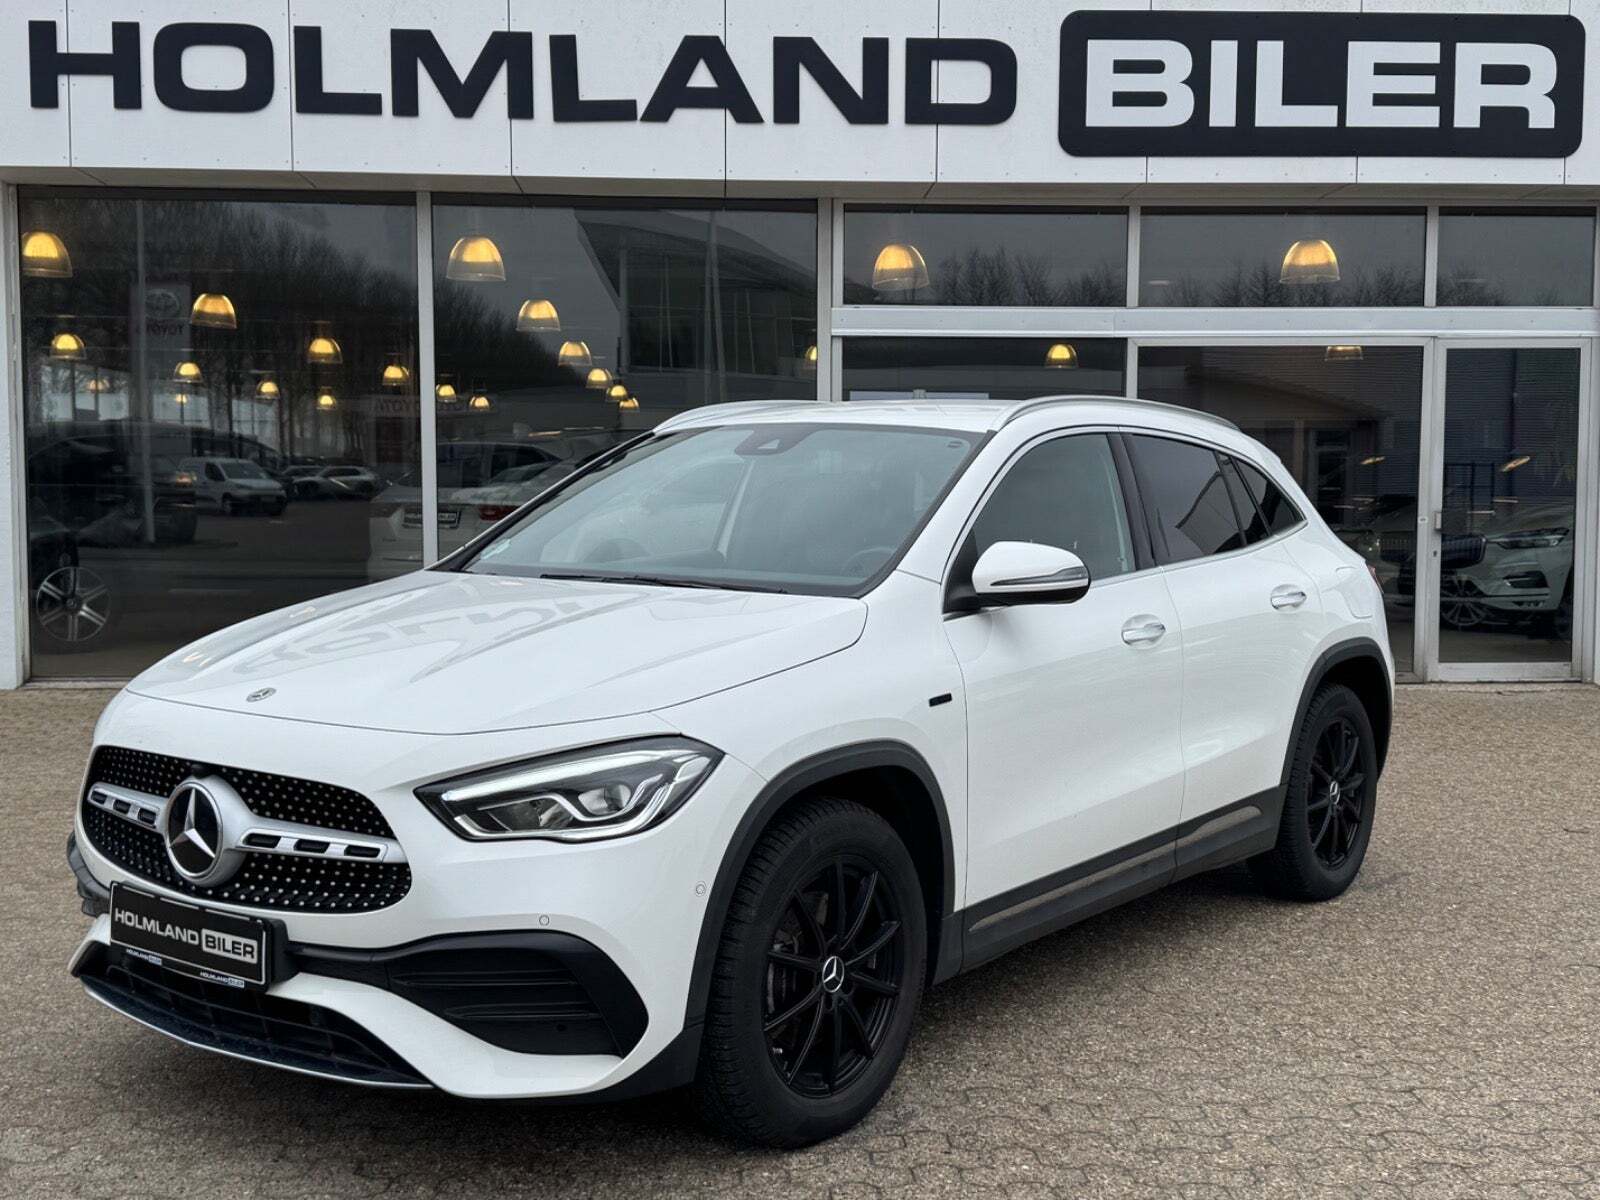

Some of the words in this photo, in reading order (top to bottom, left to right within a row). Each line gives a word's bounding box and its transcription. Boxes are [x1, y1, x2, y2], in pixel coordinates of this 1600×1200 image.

[29, 21, 1017, 127] HOLMLAND
[1086, 40, 1557, 129] BILER
[114, 907, 199, 945] HOLMLAND
[205, 934, 255, 960] BILER
